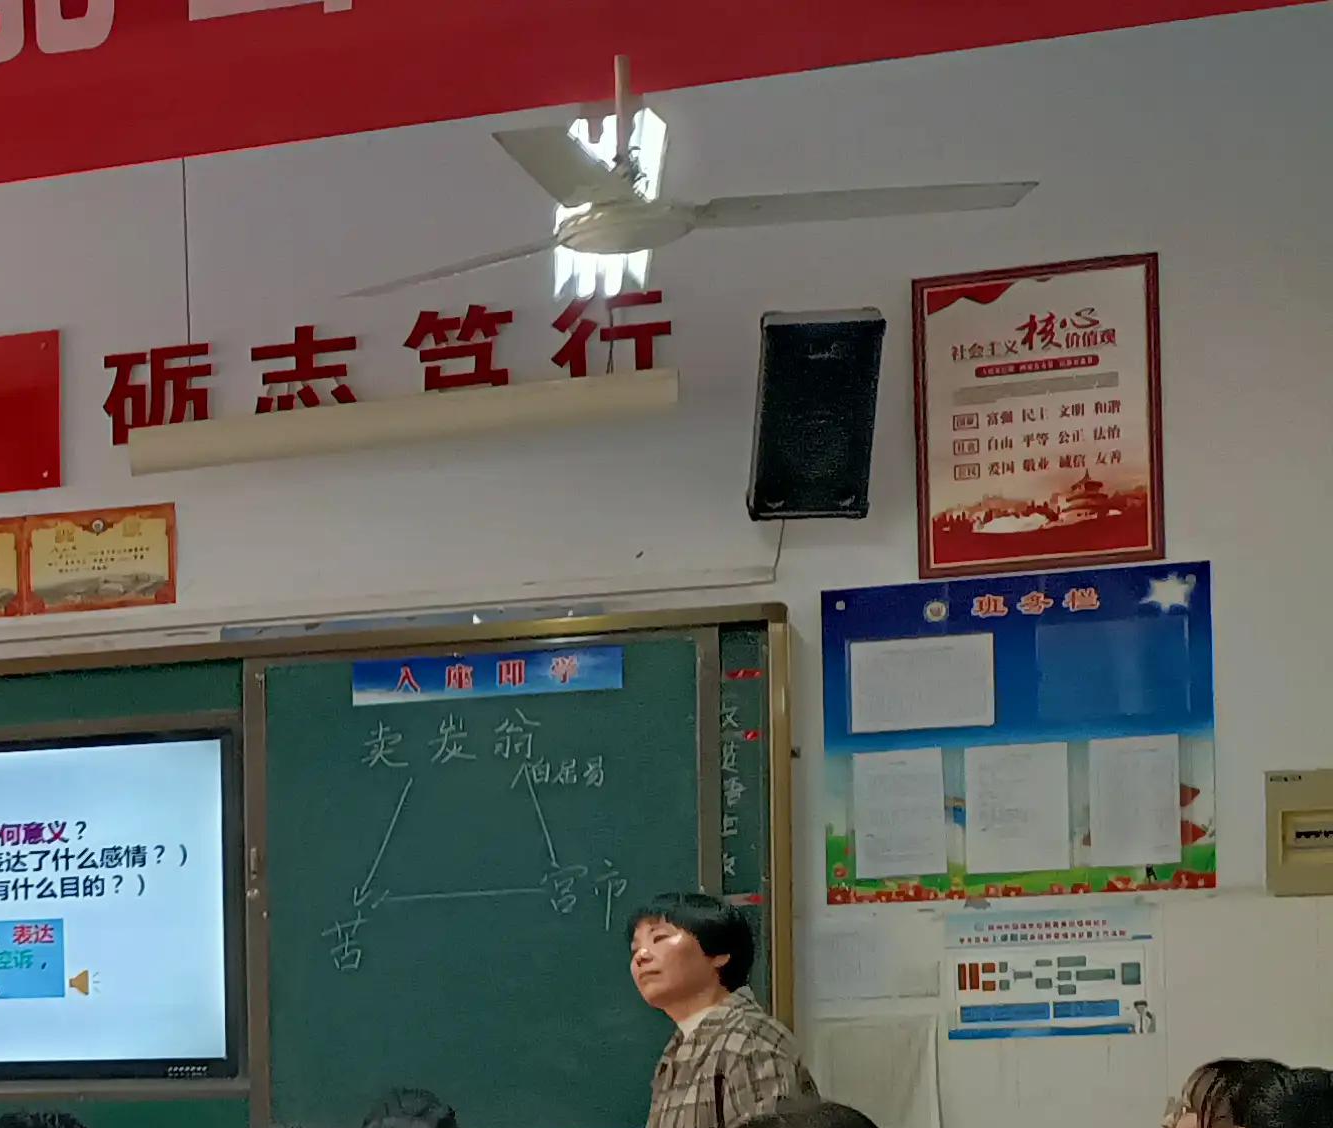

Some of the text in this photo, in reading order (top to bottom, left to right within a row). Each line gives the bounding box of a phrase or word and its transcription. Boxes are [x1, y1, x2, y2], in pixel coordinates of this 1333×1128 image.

[970, 587, 1101, 618] 班务栏
[361, 708, 541, 769] 卖炭翁
[541, 858, 628, 932] 宫市
[321, 910, 368, 972] 苦
